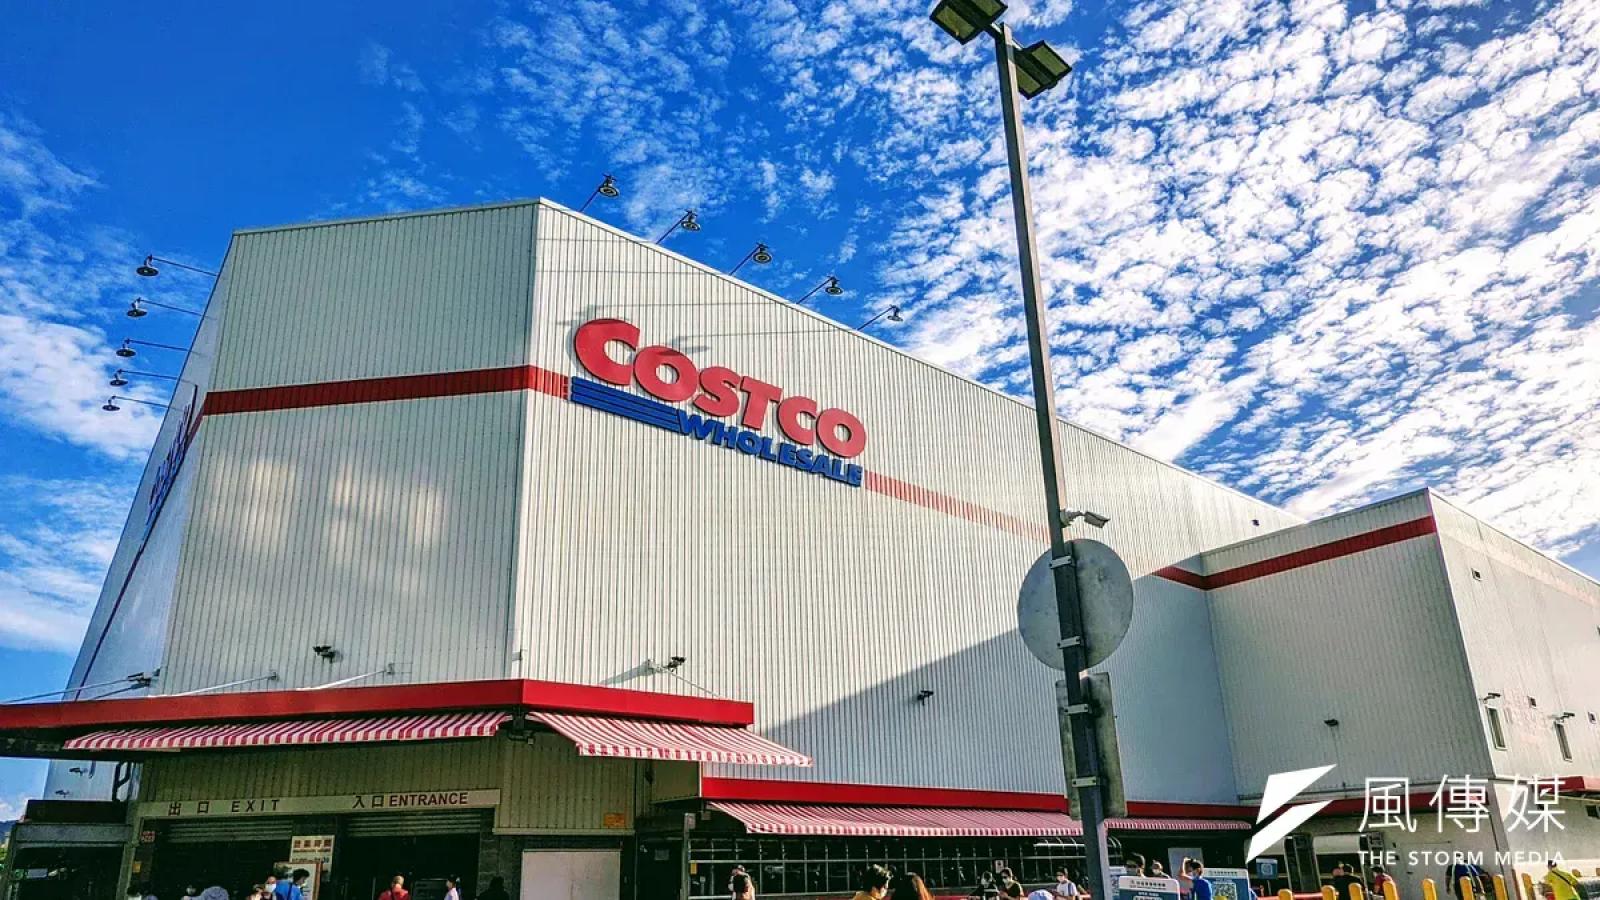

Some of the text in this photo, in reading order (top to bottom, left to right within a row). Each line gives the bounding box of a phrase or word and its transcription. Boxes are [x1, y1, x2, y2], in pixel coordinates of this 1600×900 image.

[575, 318, 867, 458] COSTCO
[676, 409, 863, 487] WHOLESALE
[167, 799, 280, 816] 出口 EXIT
[352, 791, 469, 809] 入口 ENTRANCE
